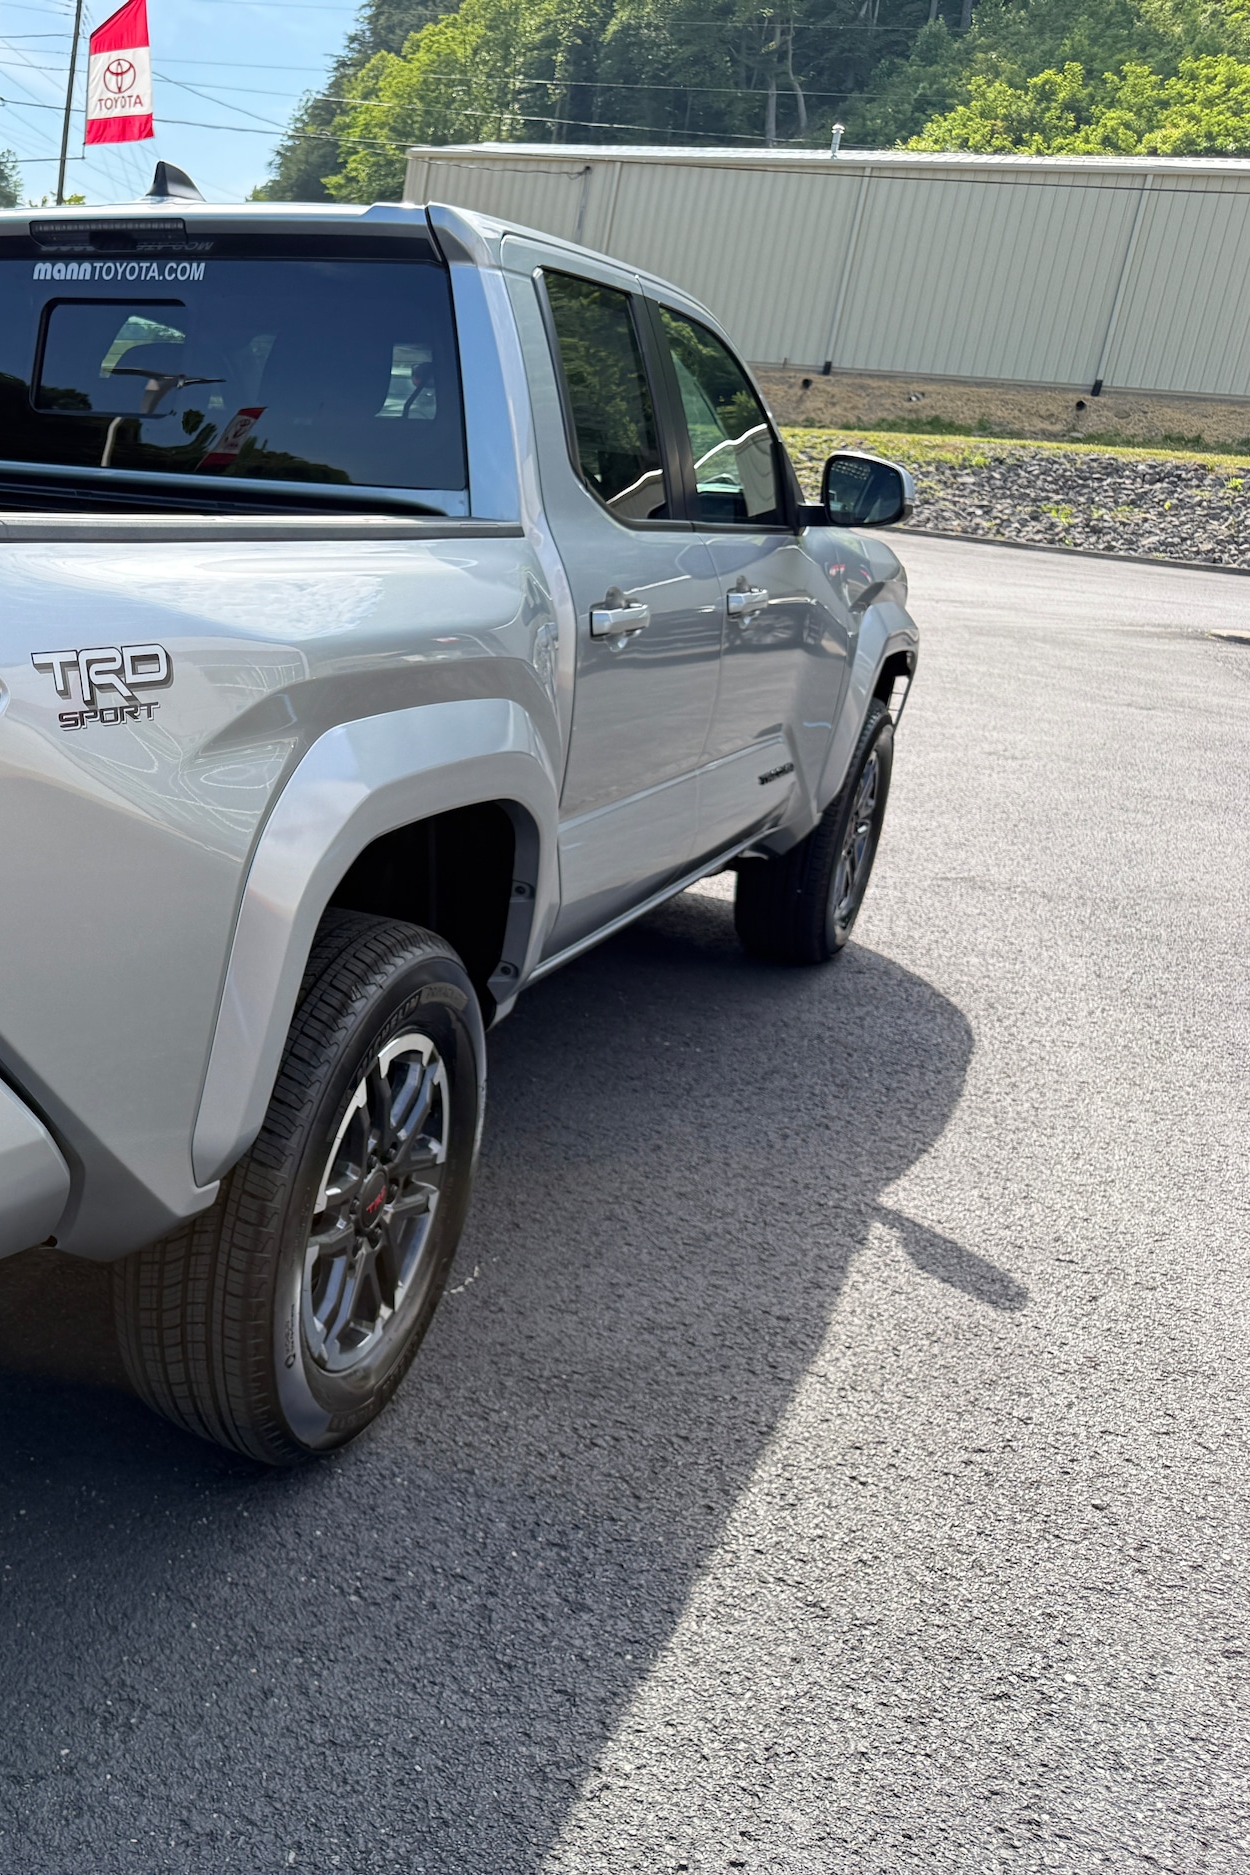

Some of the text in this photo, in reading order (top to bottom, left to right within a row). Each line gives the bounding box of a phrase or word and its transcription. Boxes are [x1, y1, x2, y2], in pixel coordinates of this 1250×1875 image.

[98, 94, 143, 111] TOYOTA
[31, 643, 174, 709] TRD
[59, 702, 160, 731] SPORT
